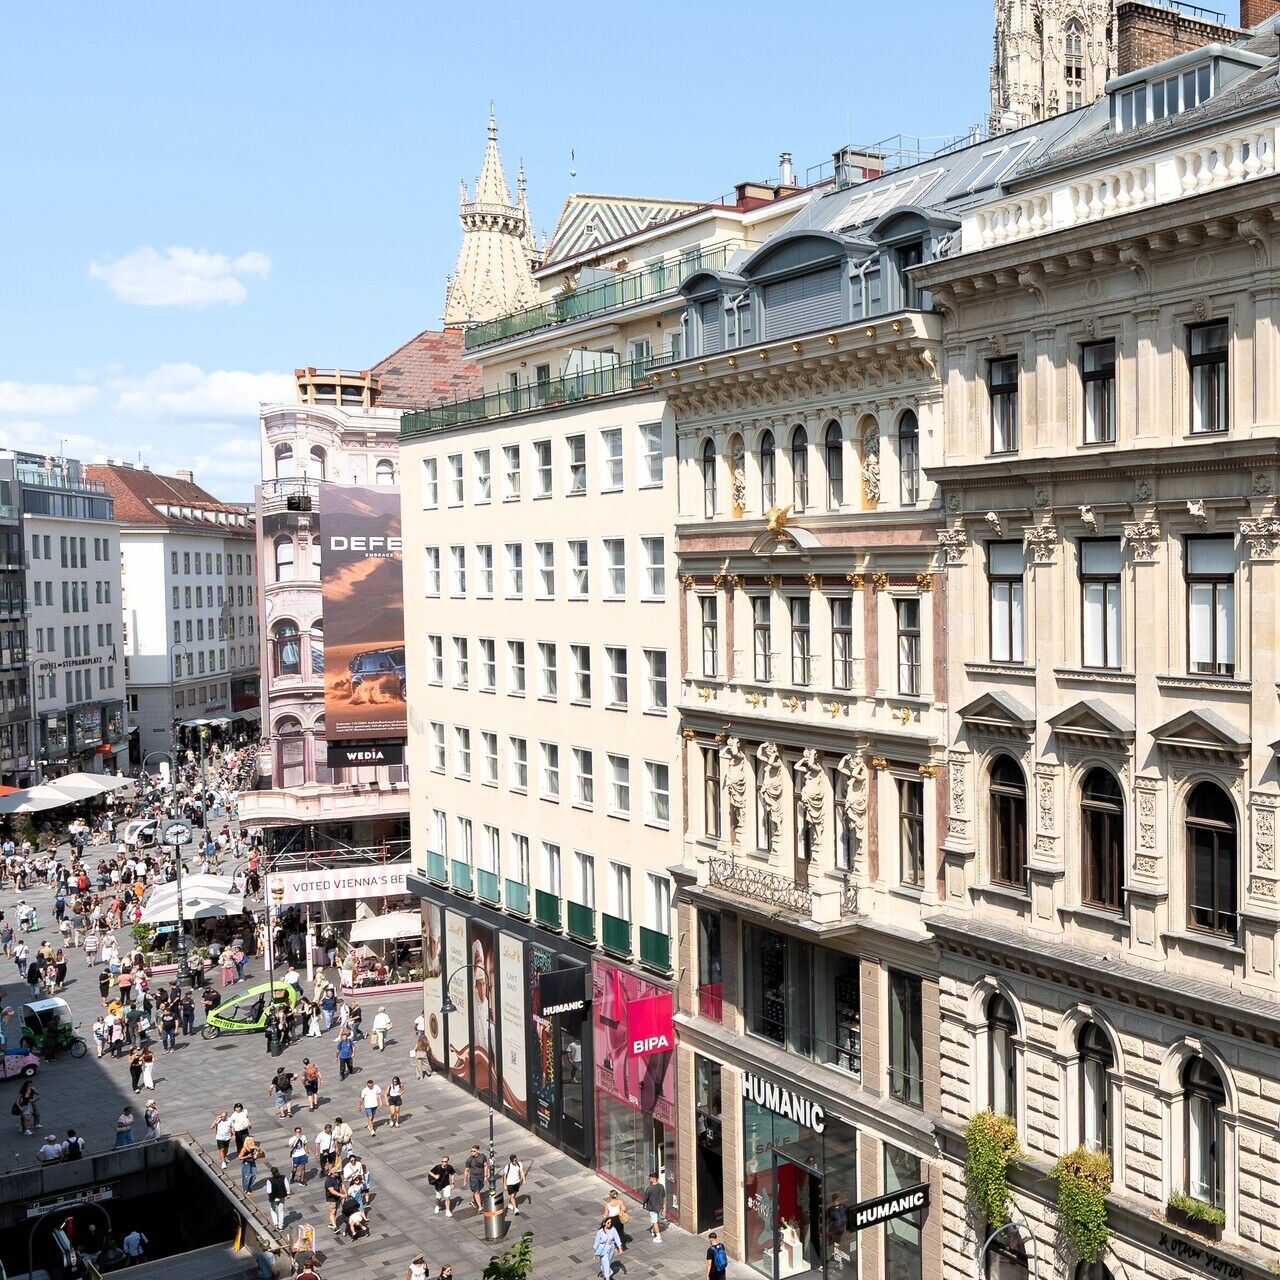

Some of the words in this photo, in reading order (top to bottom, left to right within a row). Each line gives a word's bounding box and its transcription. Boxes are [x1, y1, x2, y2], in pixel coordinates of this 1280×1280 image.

[331, 536, 402, 551] DEFE
[293, 880, 331, 892] VOTED
[334, 874, 387, 889] VIENNA'S
[390, 874, 405, 884] BE
[543, 1000, 584, 1016] HUMANIC
[633, 1035, 669, 1054] BIPA
[741, 1072, 825, 1134] HUMANIC
[856, 1192, 924, 1226] HUMANIC
